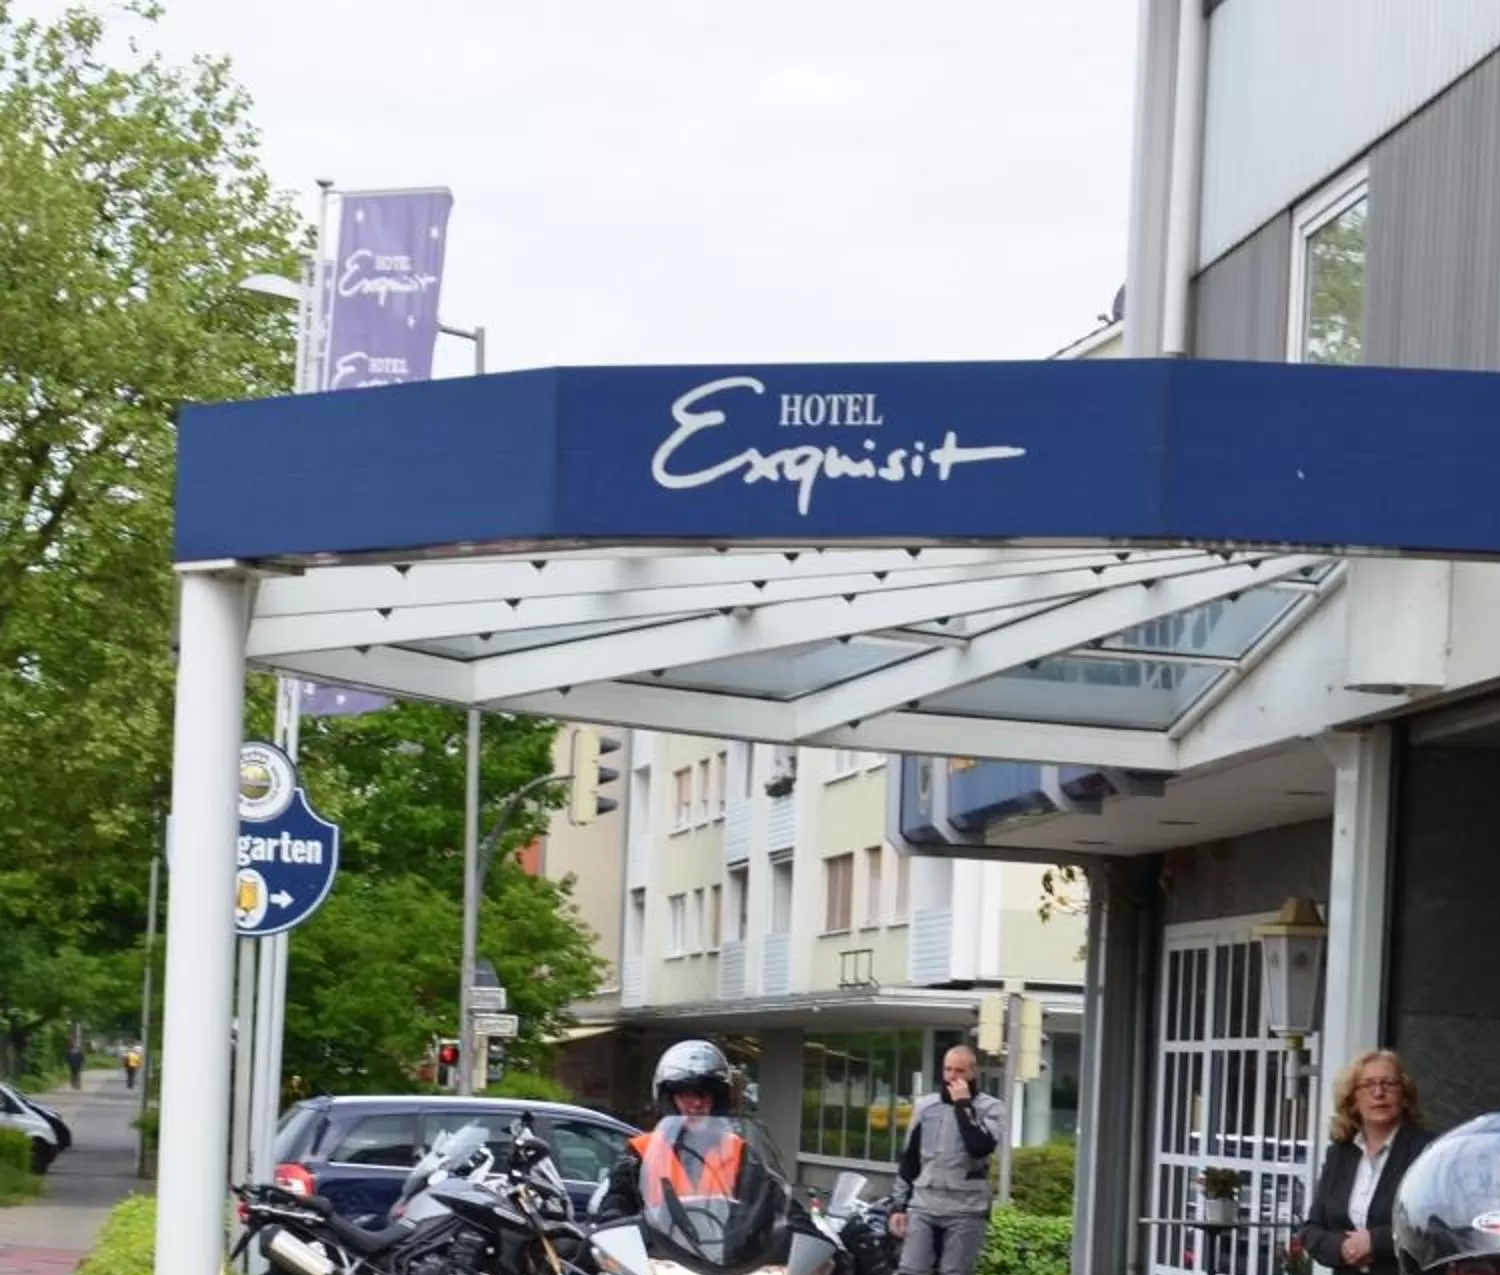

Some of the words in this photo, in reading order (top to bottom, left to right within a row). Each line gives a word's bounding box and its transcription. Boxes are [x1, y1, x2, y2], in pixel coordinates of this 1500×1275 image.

[778, 393, 883, 426] HOTEL
[651, 376, 1028, 516] Exquisit
[237, 831, 323, 866] garten
